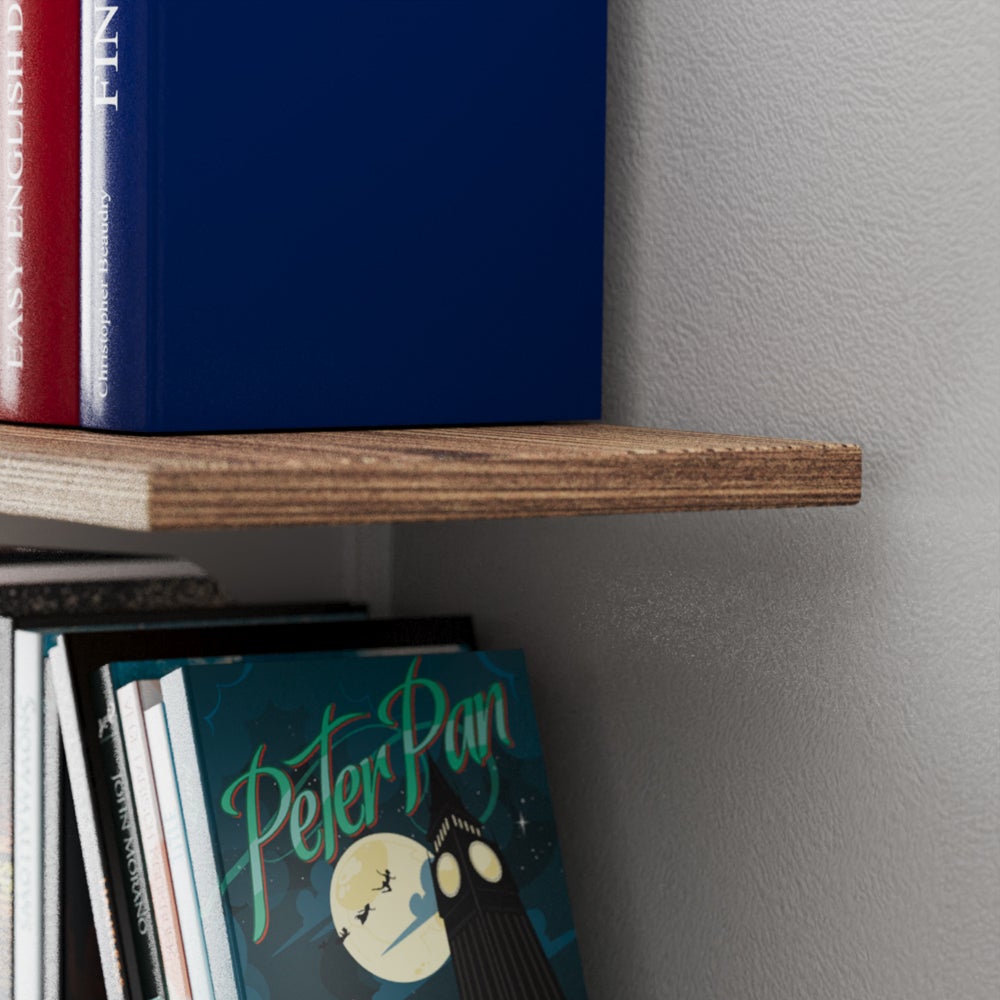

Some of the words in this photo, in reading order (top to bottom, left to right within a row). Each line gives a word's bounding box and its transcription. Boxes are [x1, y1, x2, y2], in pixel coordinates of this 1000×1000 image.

[7, 48, 23, 239] ENGLISH
[97, 190, 112, 275] Beaudry
[7, 256, 23, 368] EASY
[97, 280, 111, 398] Christopher
[110, 774, 132, 827] JOHN
[122, 832, 148, 936] MORANO
[221, 692, 396, 944] Peter
[377, 655, 516, 817] Pan
